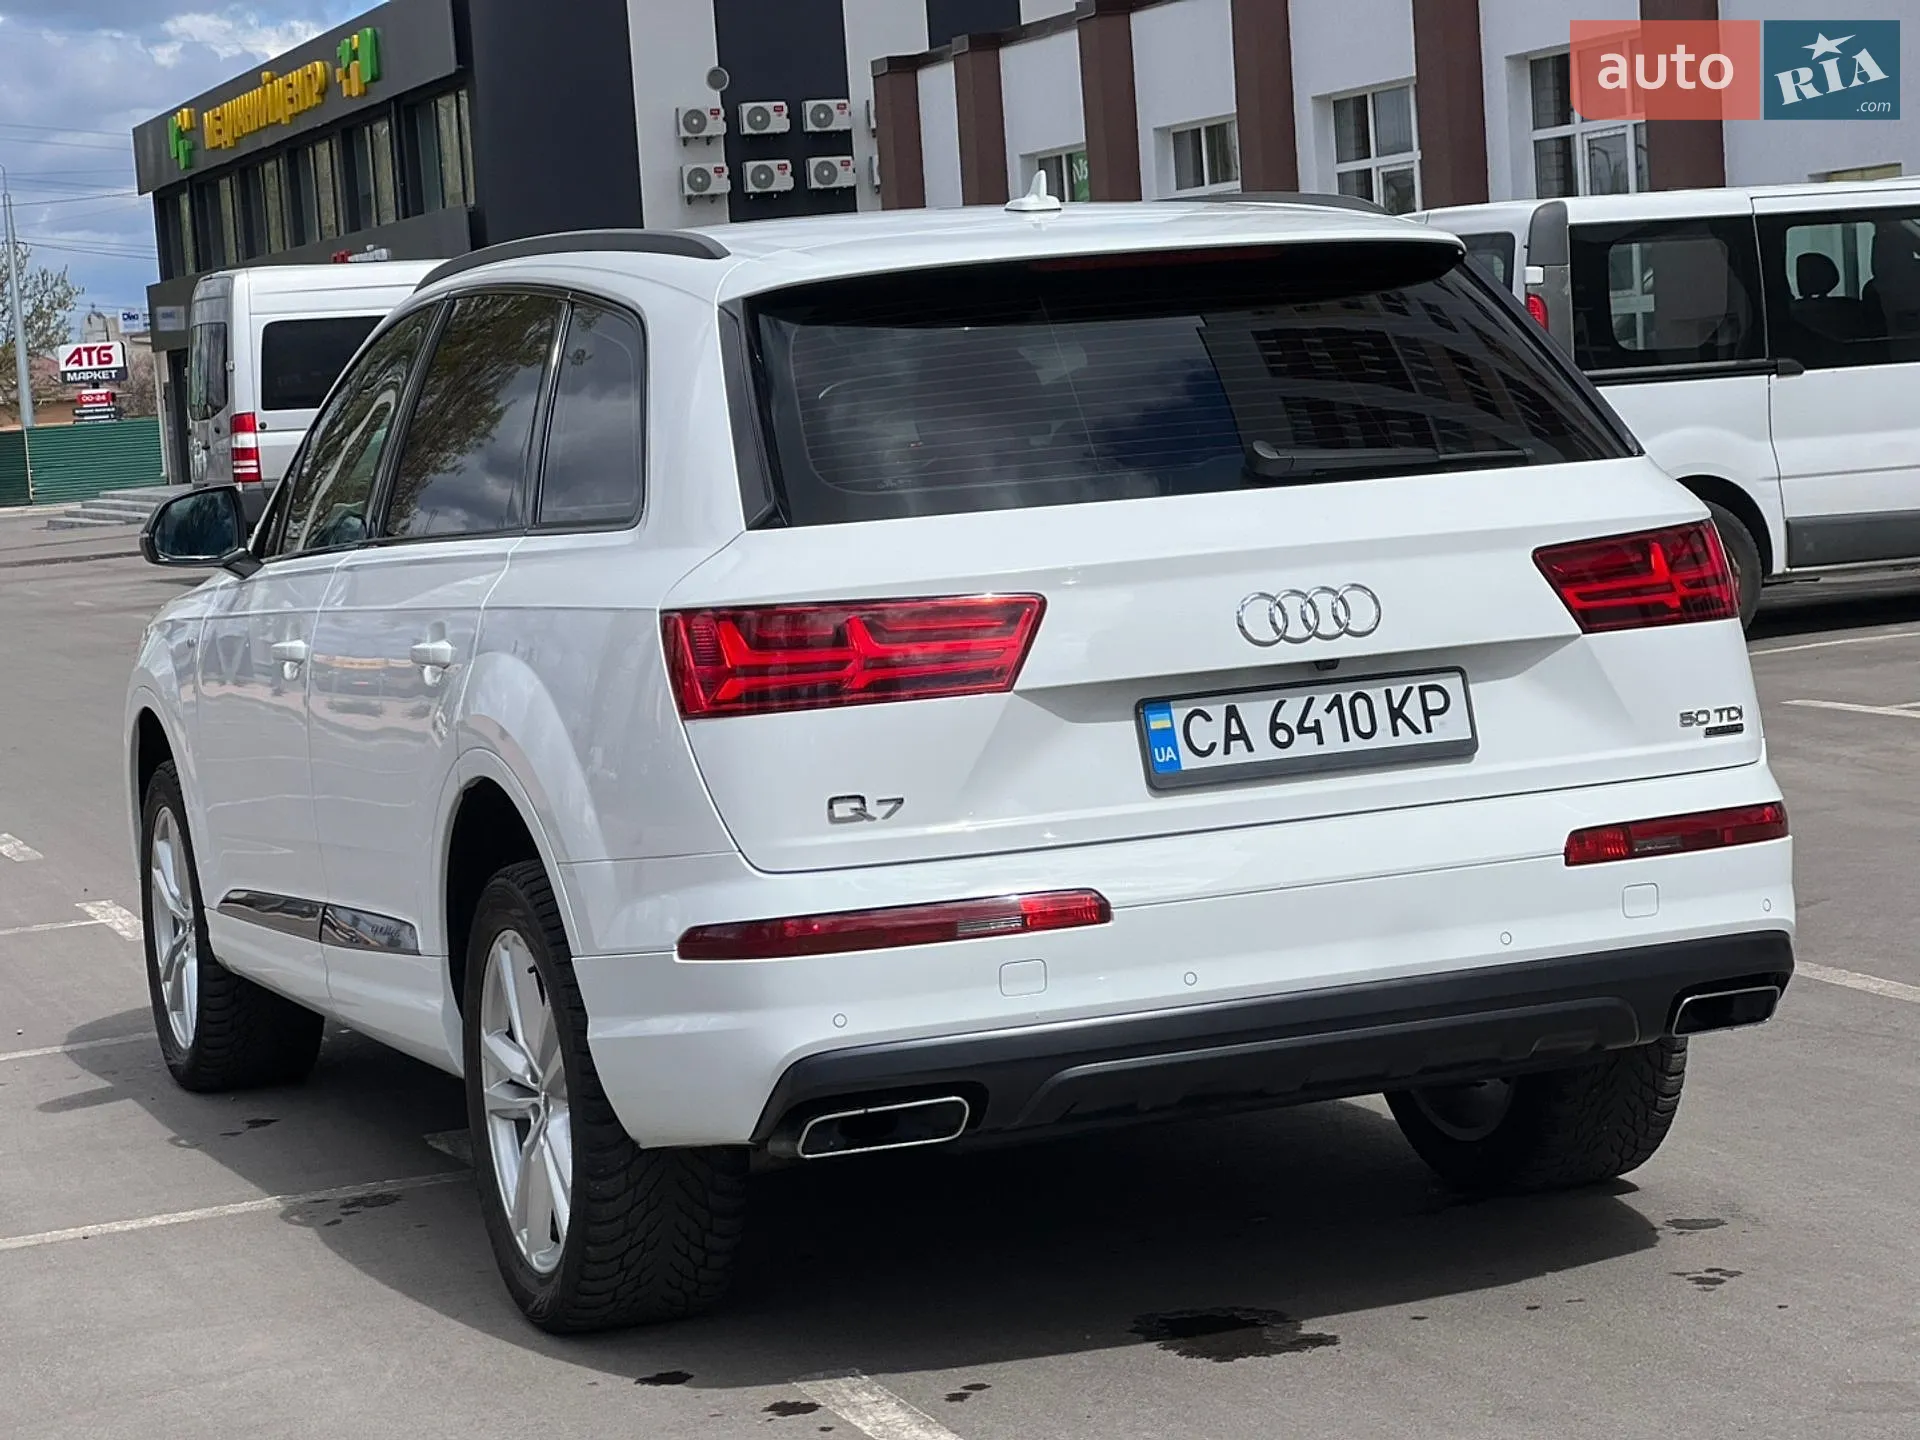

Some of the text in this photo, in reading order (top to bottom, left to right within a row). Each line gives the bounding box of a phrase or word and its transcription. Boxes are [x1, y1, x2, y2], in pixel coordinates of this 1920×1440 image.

[66, 369, 118, 382] МАРКЕТ
[1268, 690, 1378, 750] 6410
[1679, 704, 1743, 727] 50 TDI
[1154, 748, 1177, 763] UA
[827, 794, 904, 825] Q7
